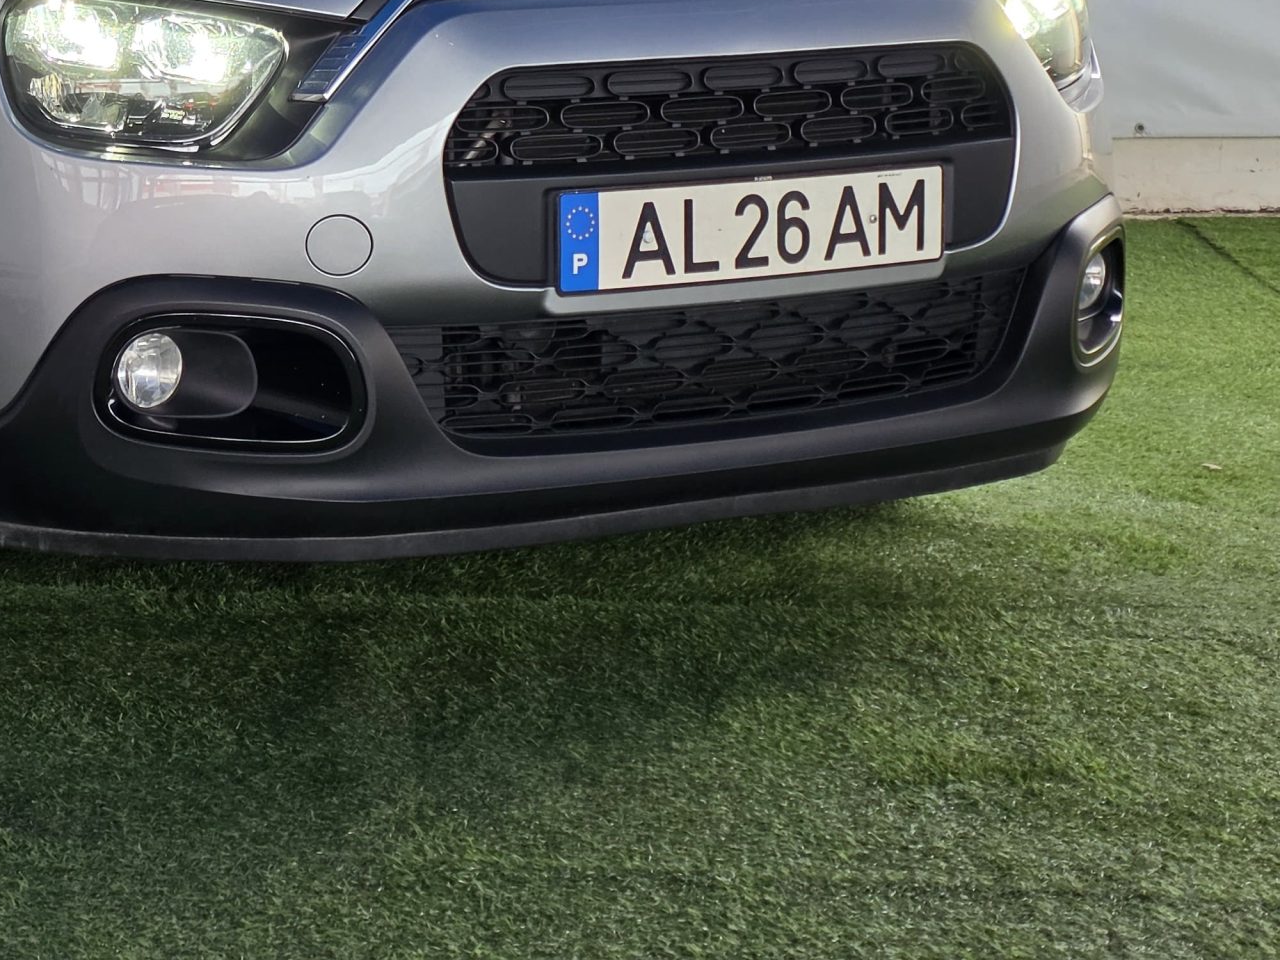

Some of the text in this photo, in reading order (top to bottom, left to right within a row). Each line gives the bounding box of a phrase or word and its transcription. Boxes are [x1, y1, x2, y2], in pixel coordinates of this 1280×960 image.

[621, 179, 925, 279] AL 26 AM
[572, 253, 588, 274] P
